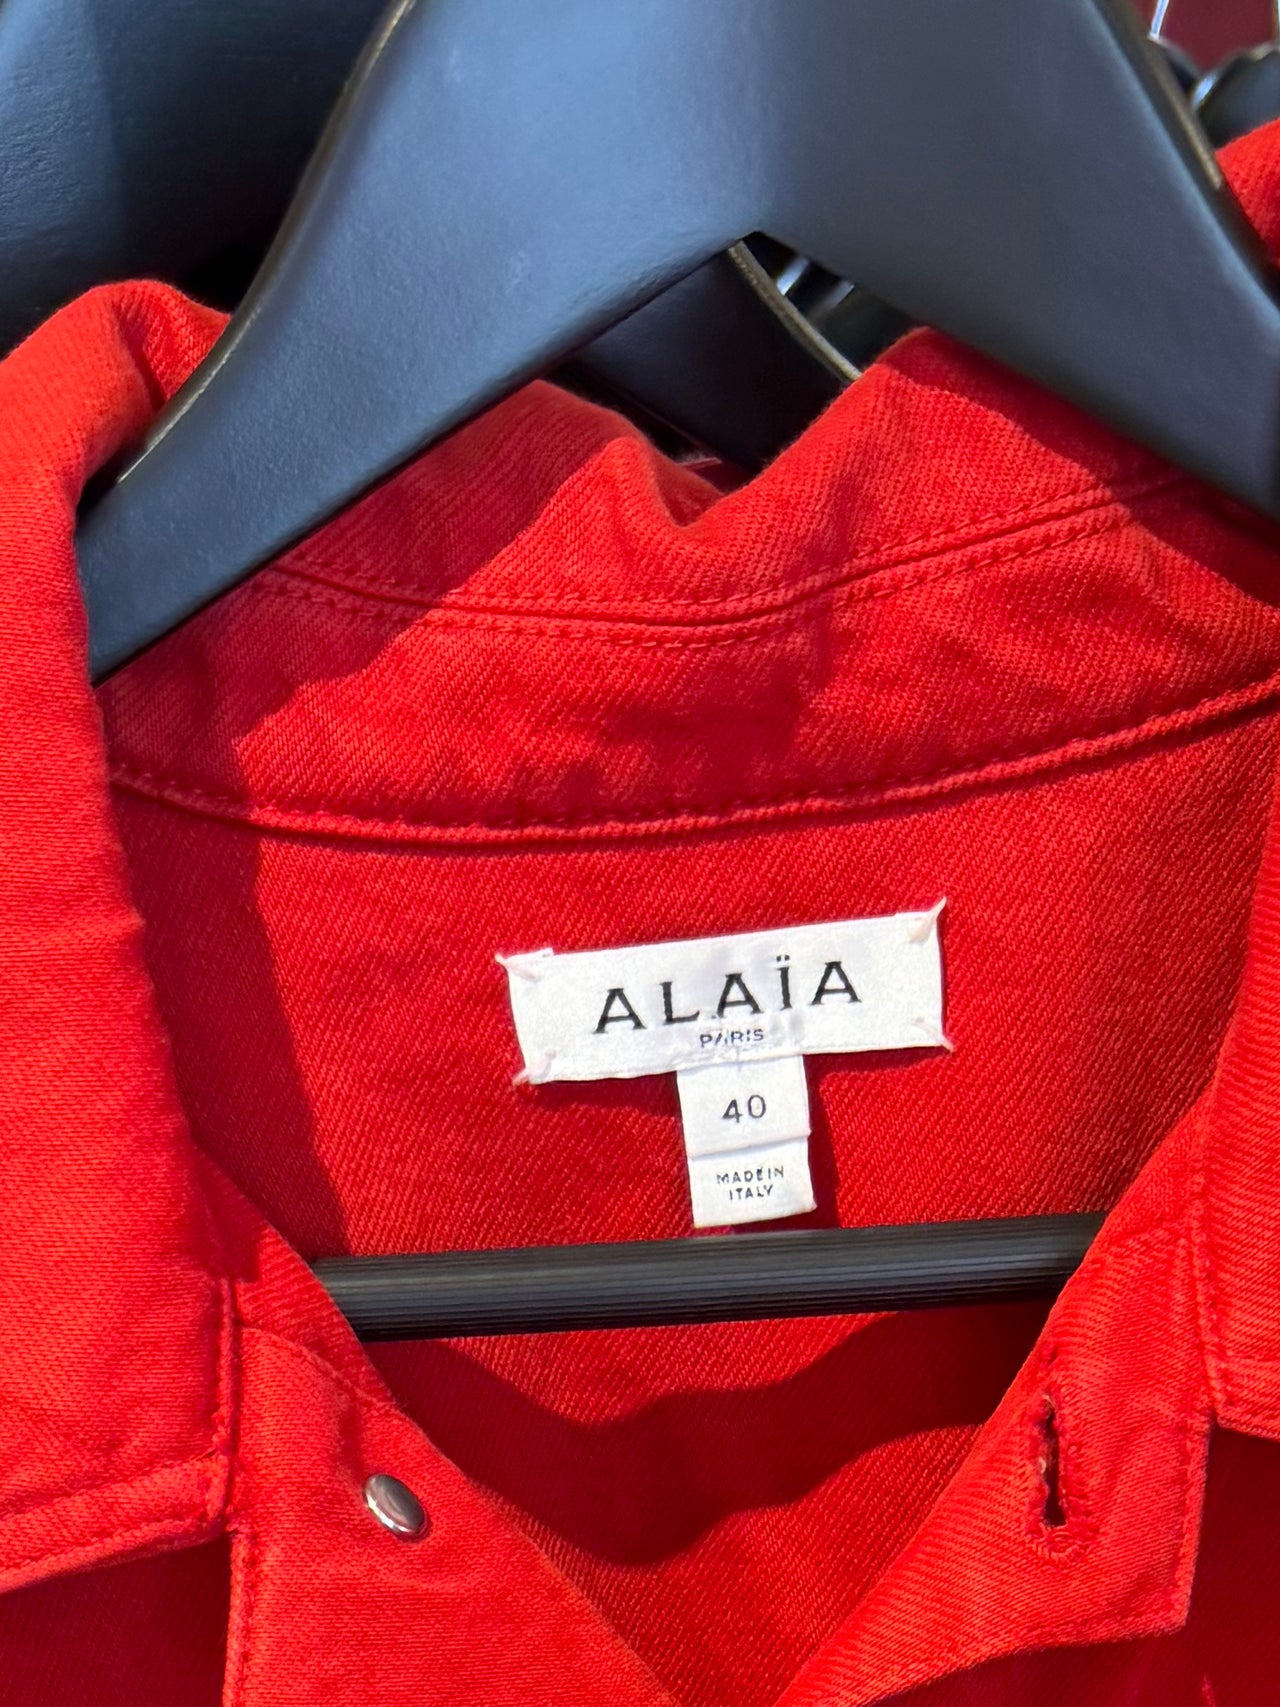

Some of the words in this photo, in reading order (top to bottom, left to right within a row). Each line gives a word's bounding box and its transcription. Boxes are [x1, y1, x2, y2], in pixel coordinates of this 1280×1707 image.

[593, 954, 862, 1034] ALAÏA
[699, 1028, 765, 1049] PARIS
[721, 1094, 768, 1124] 40
[716, 1167, 764, 1184] MADE
[728, 1183, 774, 1201] ITALY
